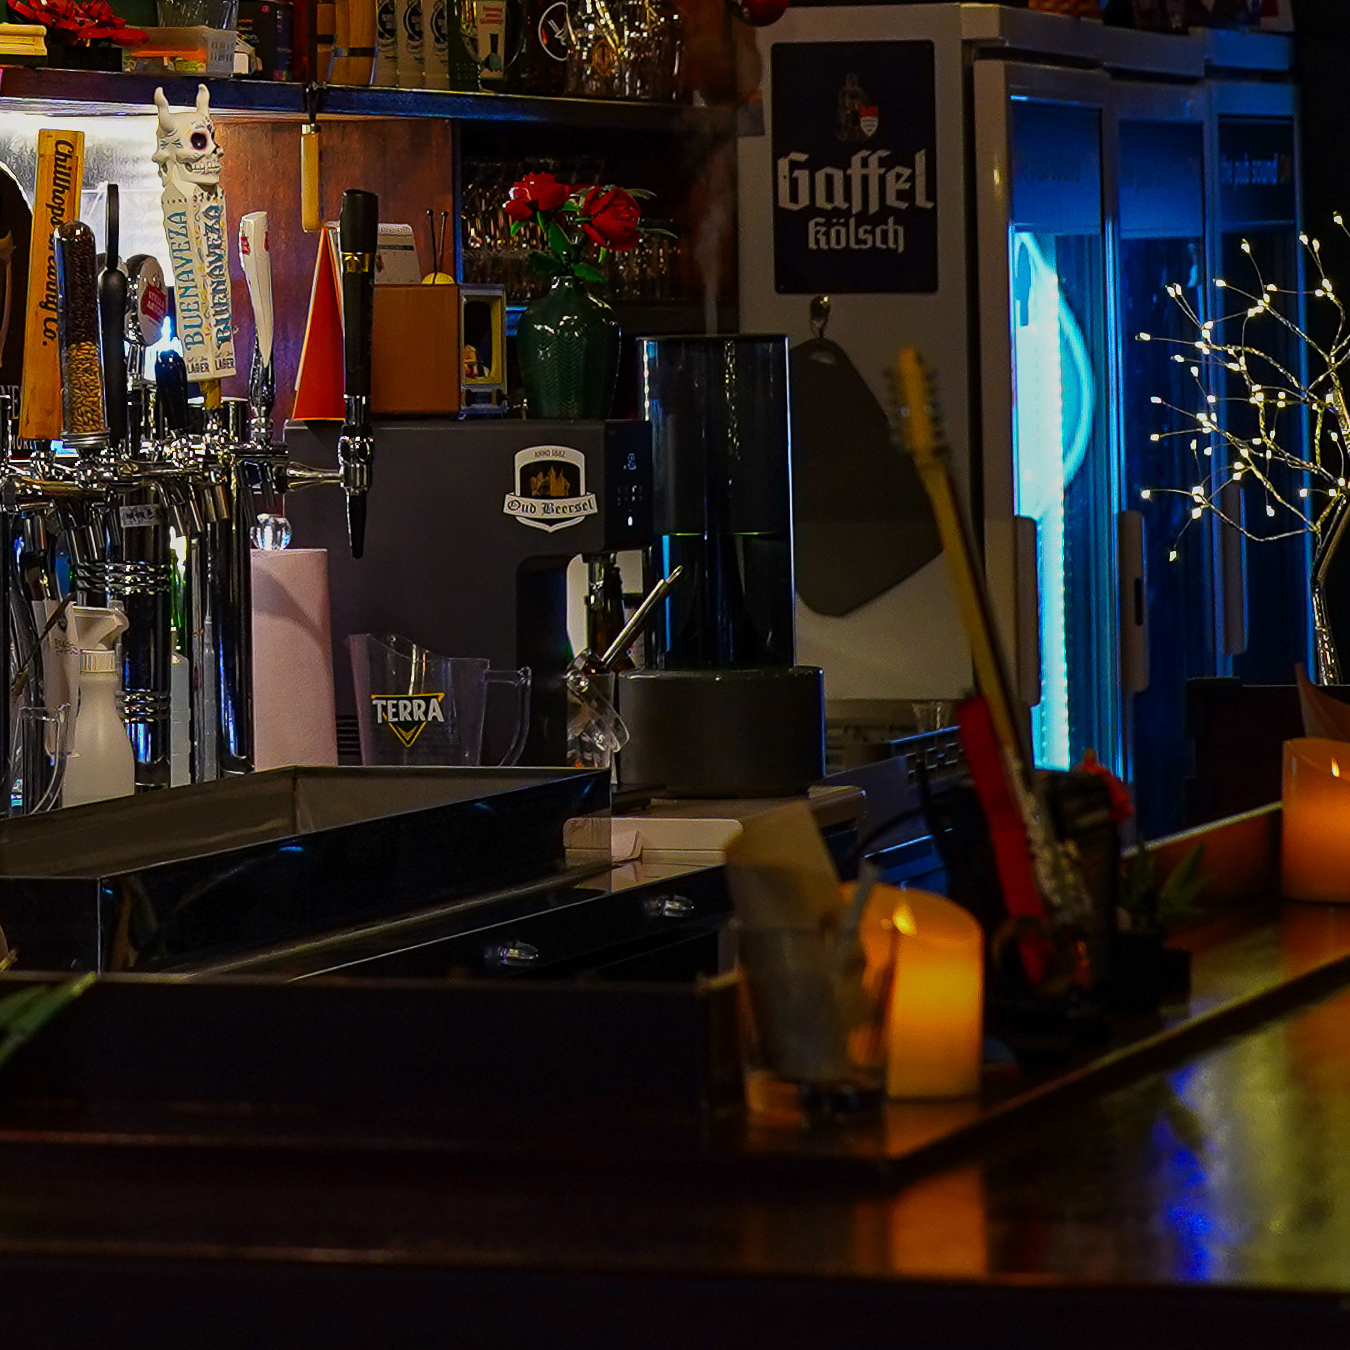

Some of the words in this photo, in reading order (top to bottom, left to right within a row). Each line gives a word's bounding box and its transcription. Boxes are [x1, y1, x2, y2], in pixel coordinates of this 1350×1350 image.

[777, 149, 935, 216] Gaffel
[167, 211, 205, 351] BUENAVEZA
[202, 205, 232, 350] BUENAVEZA
[187, 362, 210, 374] LAGER
[214, 357, 235, 371] LAGER
[507, 499, 537, 515] Oud
[541, 498, 595, 516] Beersel
[372, 698, 445, 724] TERRA
